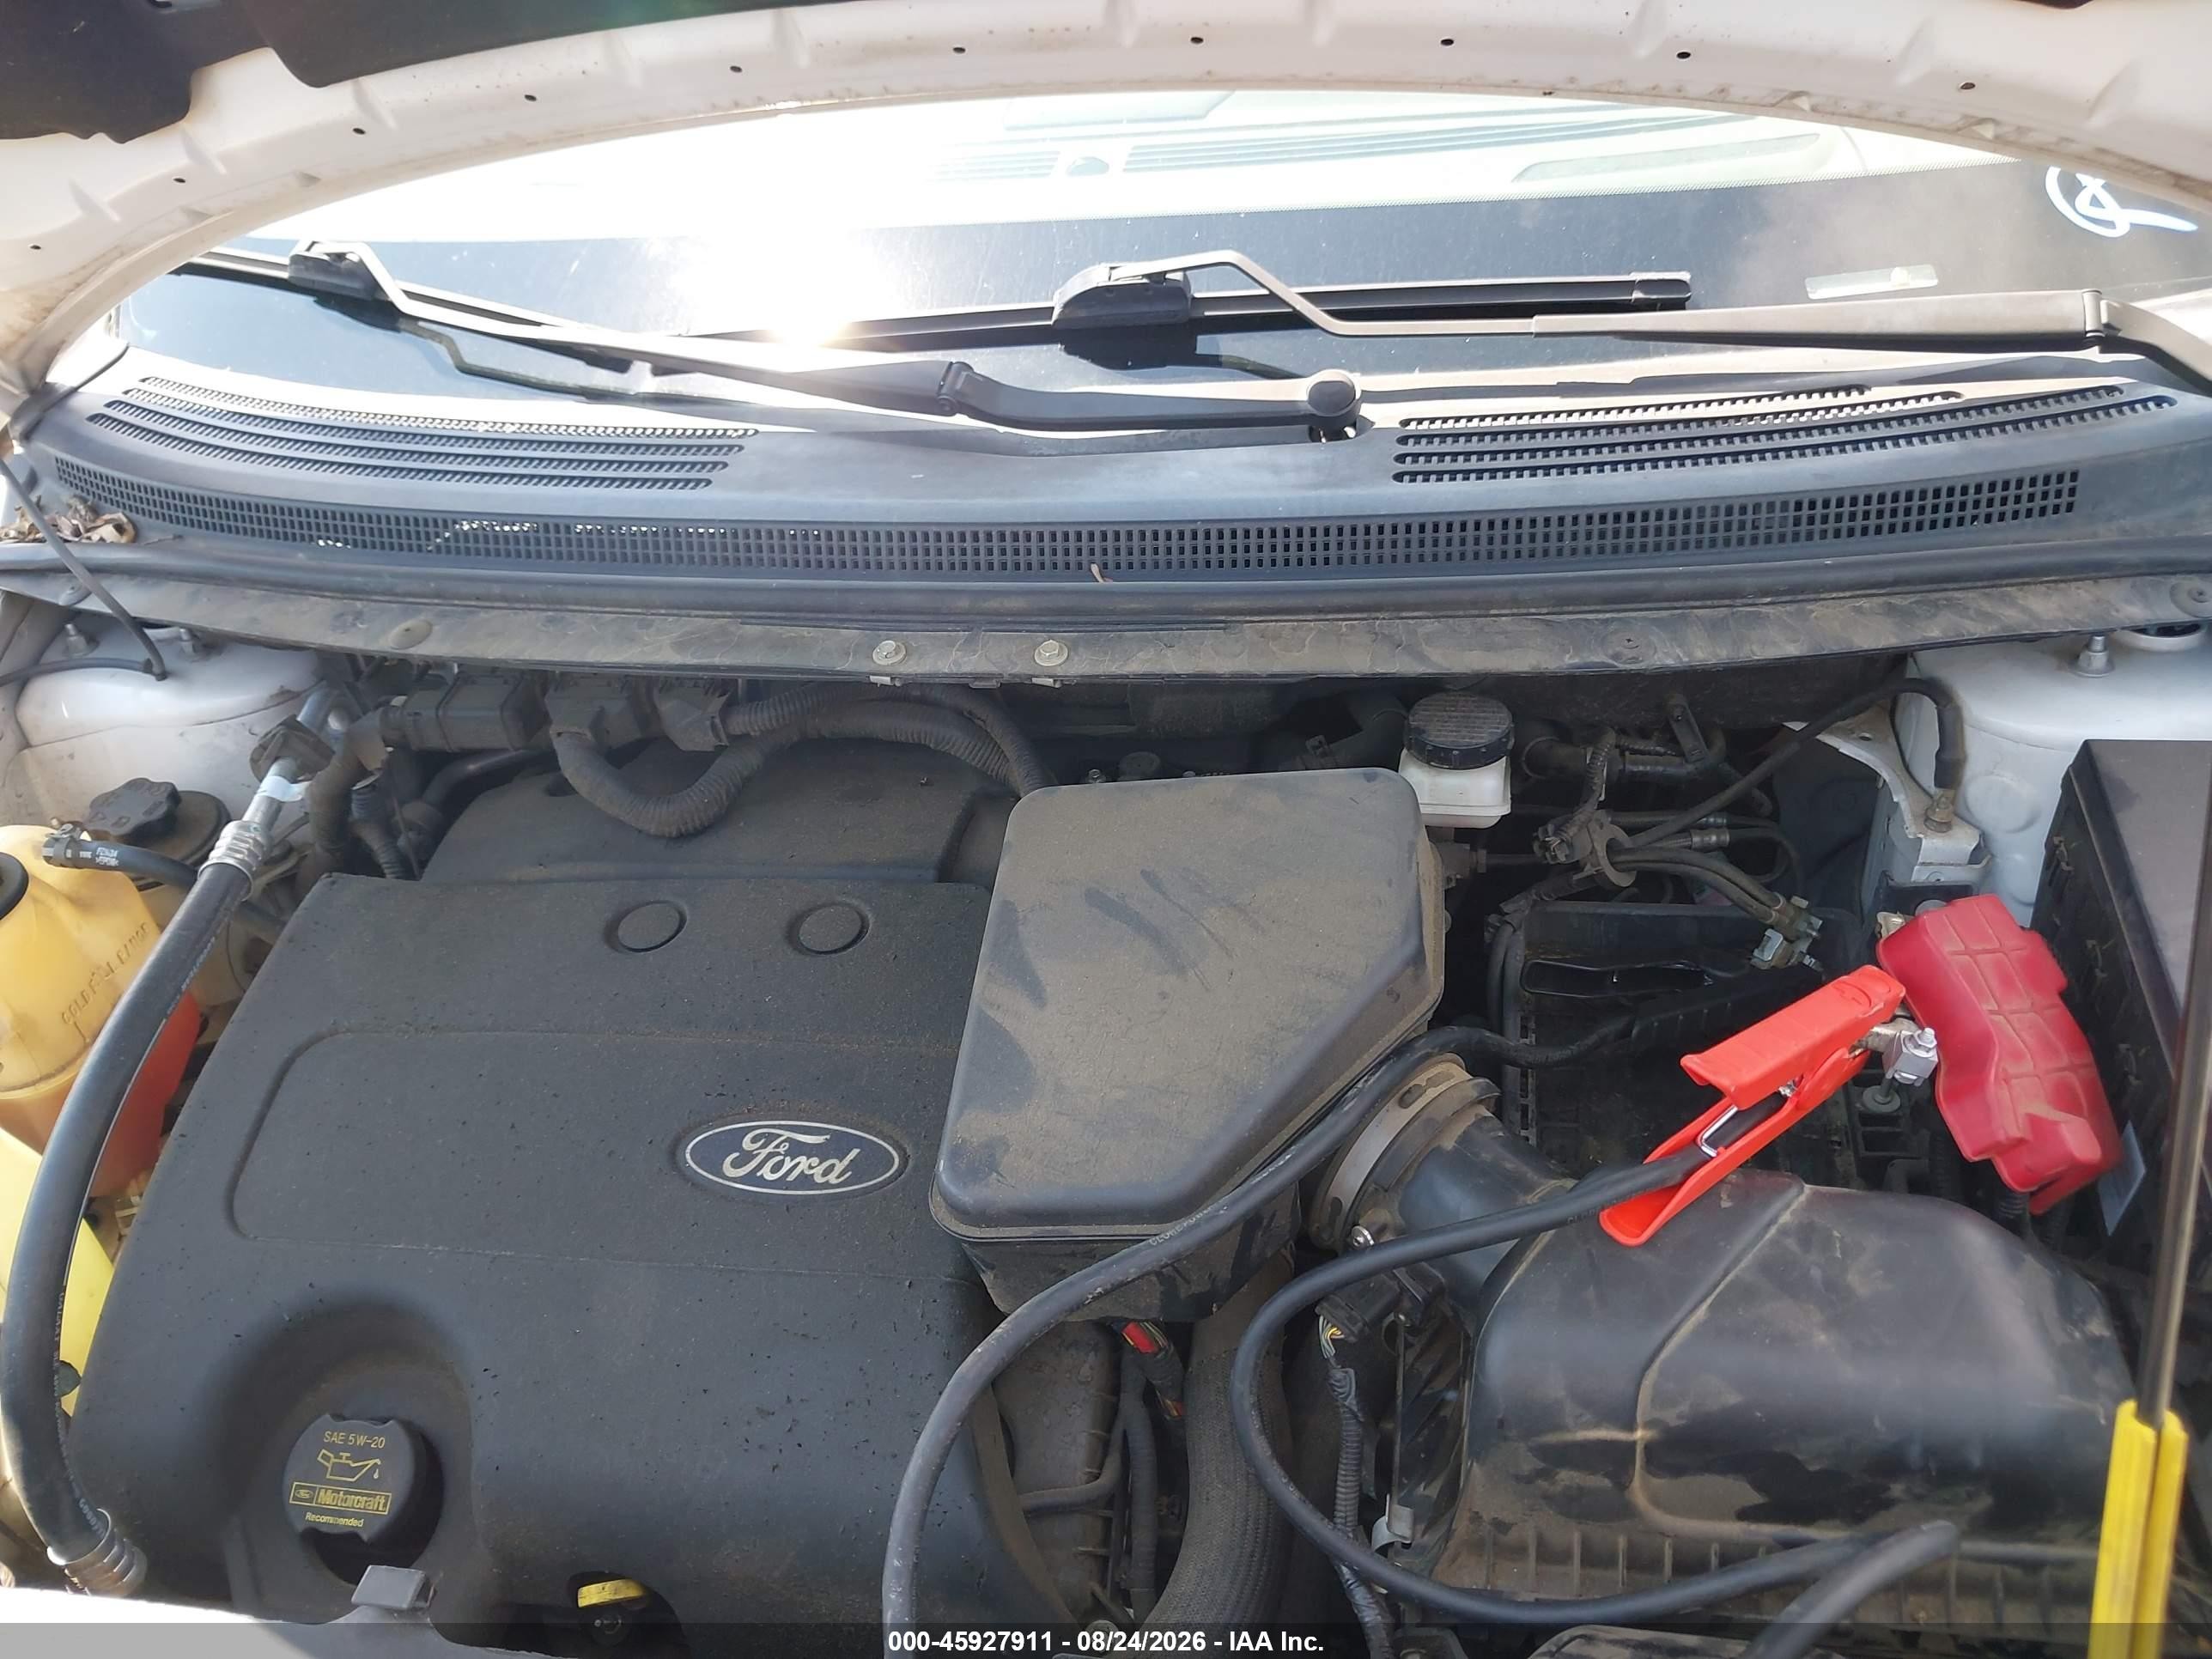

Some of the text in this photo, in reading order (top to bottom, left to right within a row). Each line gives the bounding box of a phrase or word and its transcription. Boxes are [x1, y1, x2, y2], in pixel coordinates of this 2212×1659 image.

[61, 988, 93, 1024] COLD
[722, 1127, 862, 1185] Ford
[323, 1431, 386, 1449] SAE 5W-20
[317, 1488, 386, 1512] Motorcraft
[304, 1512, 364, 1528] Recommended
